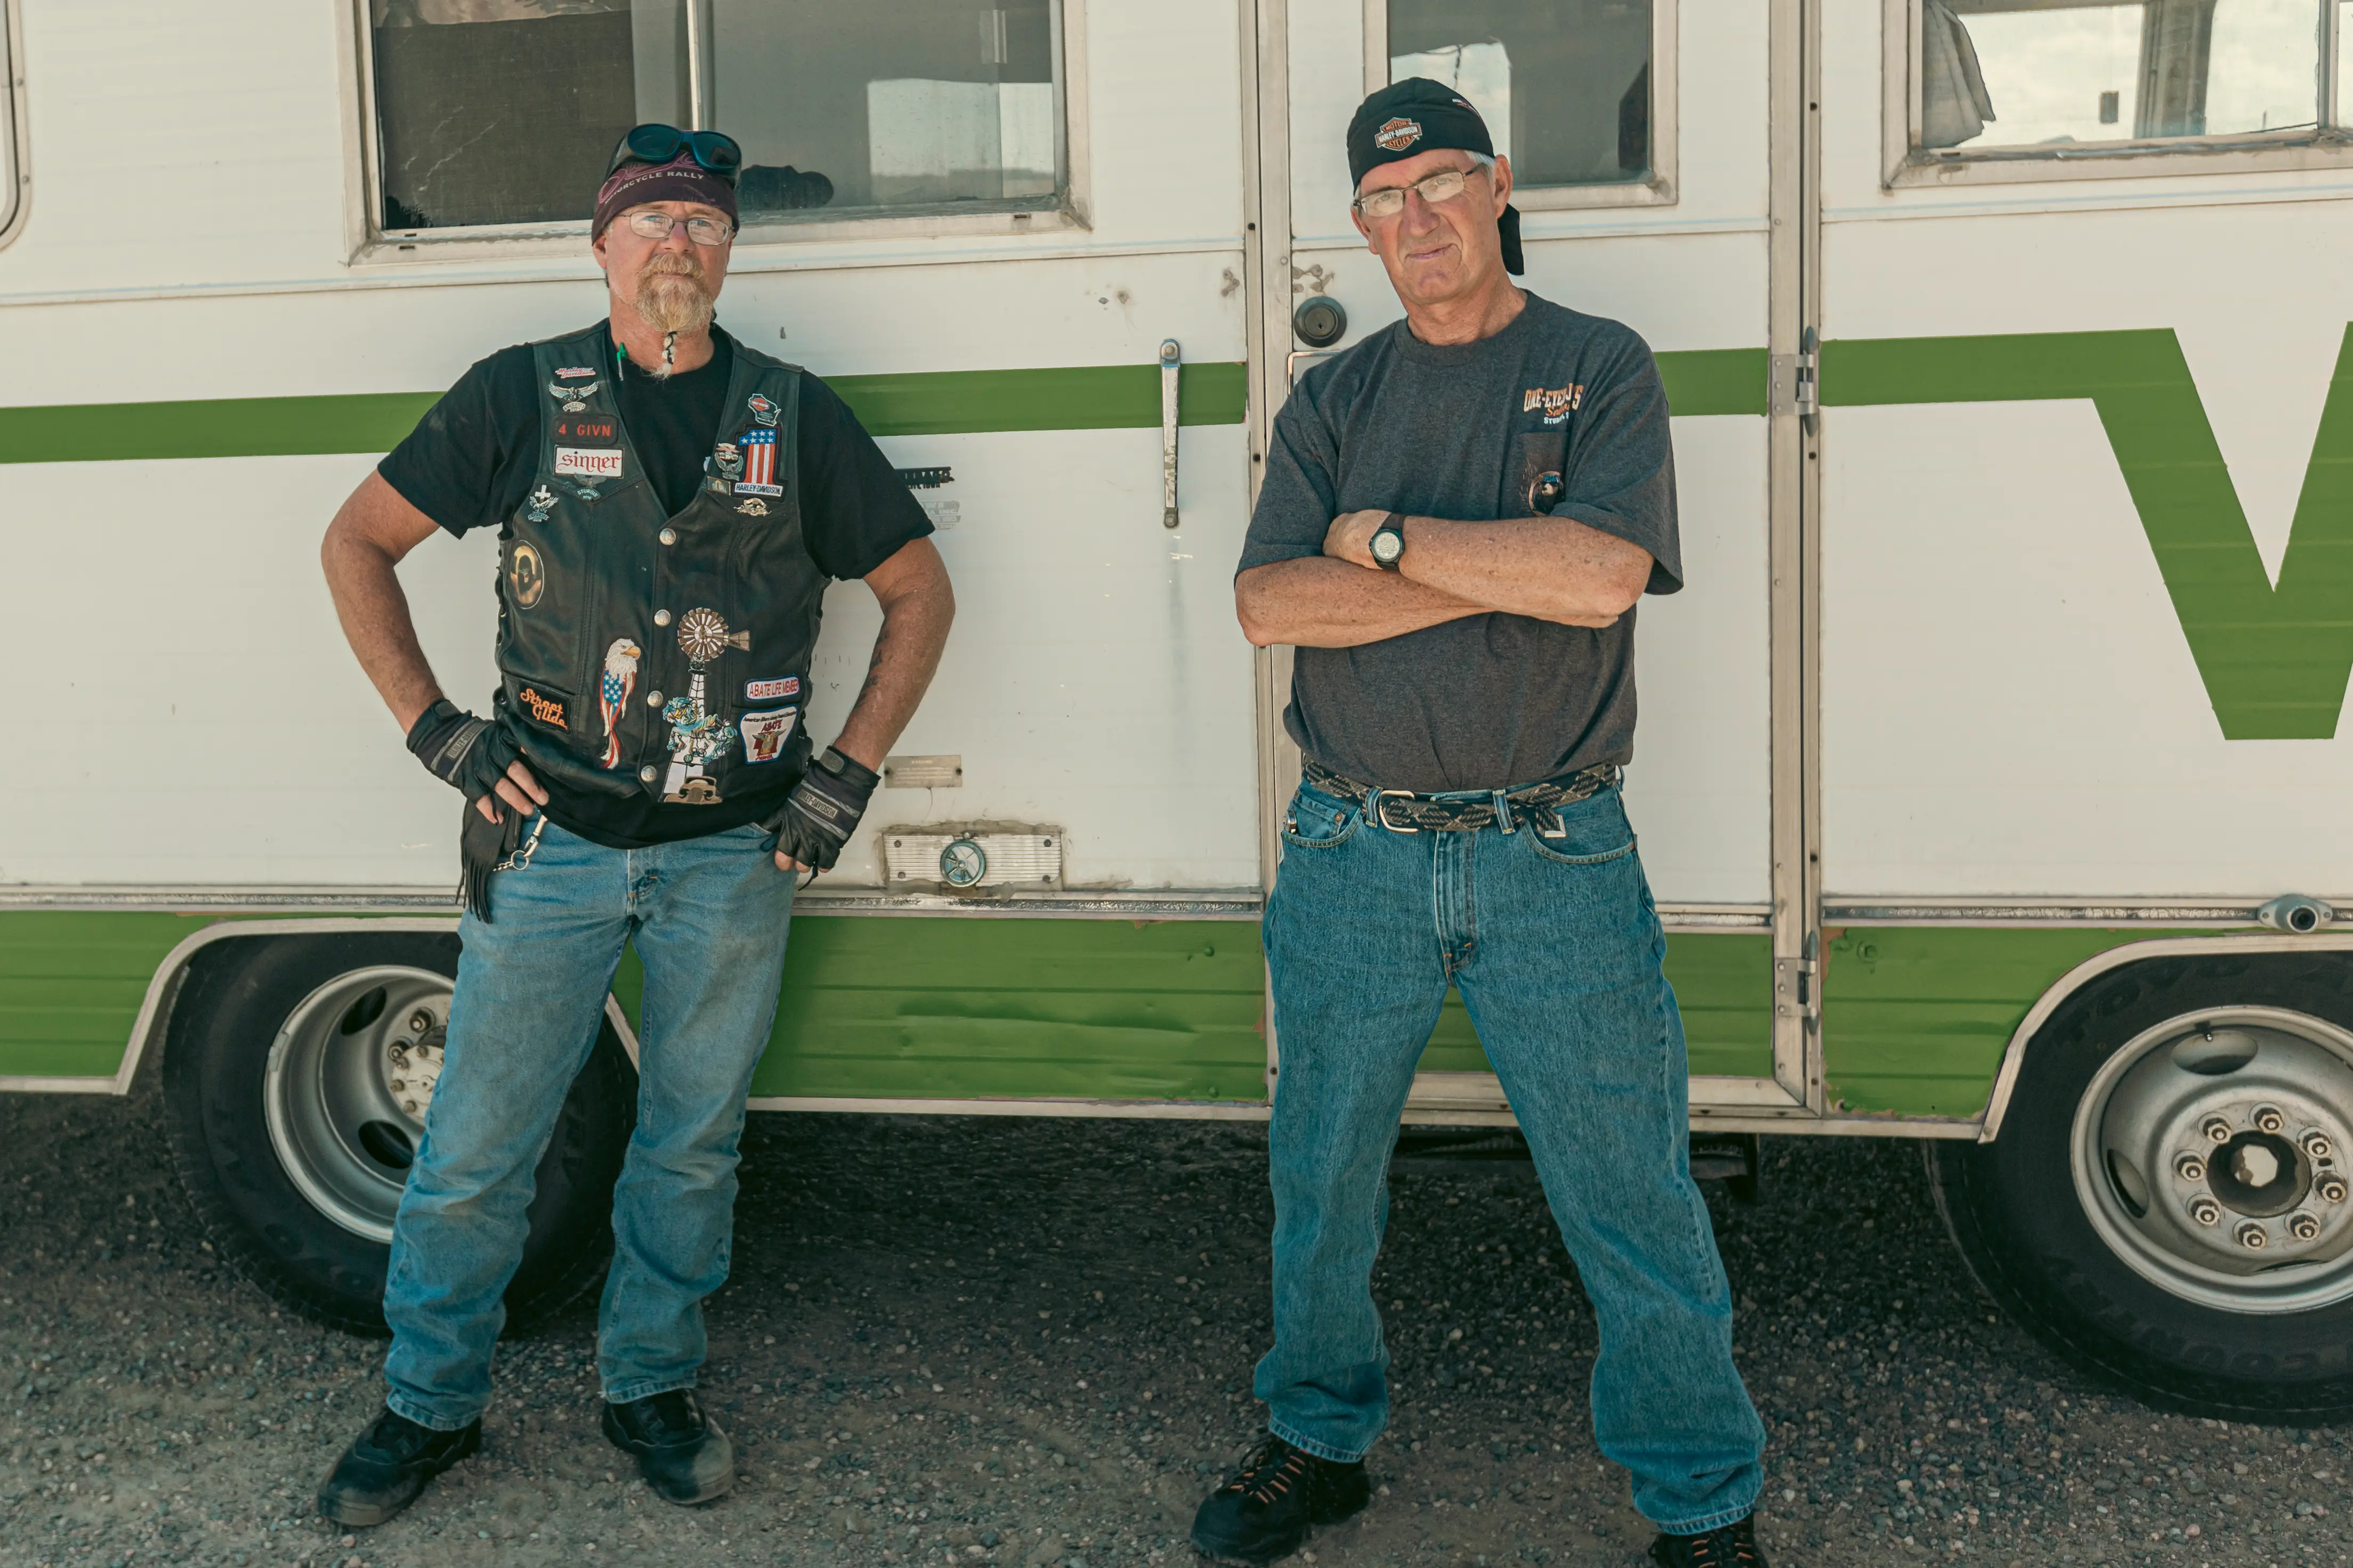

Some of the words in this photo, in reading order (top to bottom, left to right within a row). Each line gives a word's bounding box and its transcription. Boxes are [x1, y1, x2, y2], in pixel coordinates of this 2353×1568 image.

[1386, 120, 1407, 131] MOTOR
[1379, 126, 1418, 143] HARLEY-DAVIDSON
[1389, 136, 1410, 147] CYCLES
[667, 171, 704, 180] RALLY
[559, 424, 567, 435] 4
[577, 424, 611, 437] GIVN
[556, 451, 621, 473] sinner
[577, 489, 598, 497] STURGIS
[736, 484, 781, 495] HARLEY-DAVIDSON
[749, 683, 771, 697] ABATE
[771, 682, 782, 695] LIFE
[520, 688, 563, 714] Street
[532, 704, 568, 730] Glide
[761, 719, 783, 733] ABATE
